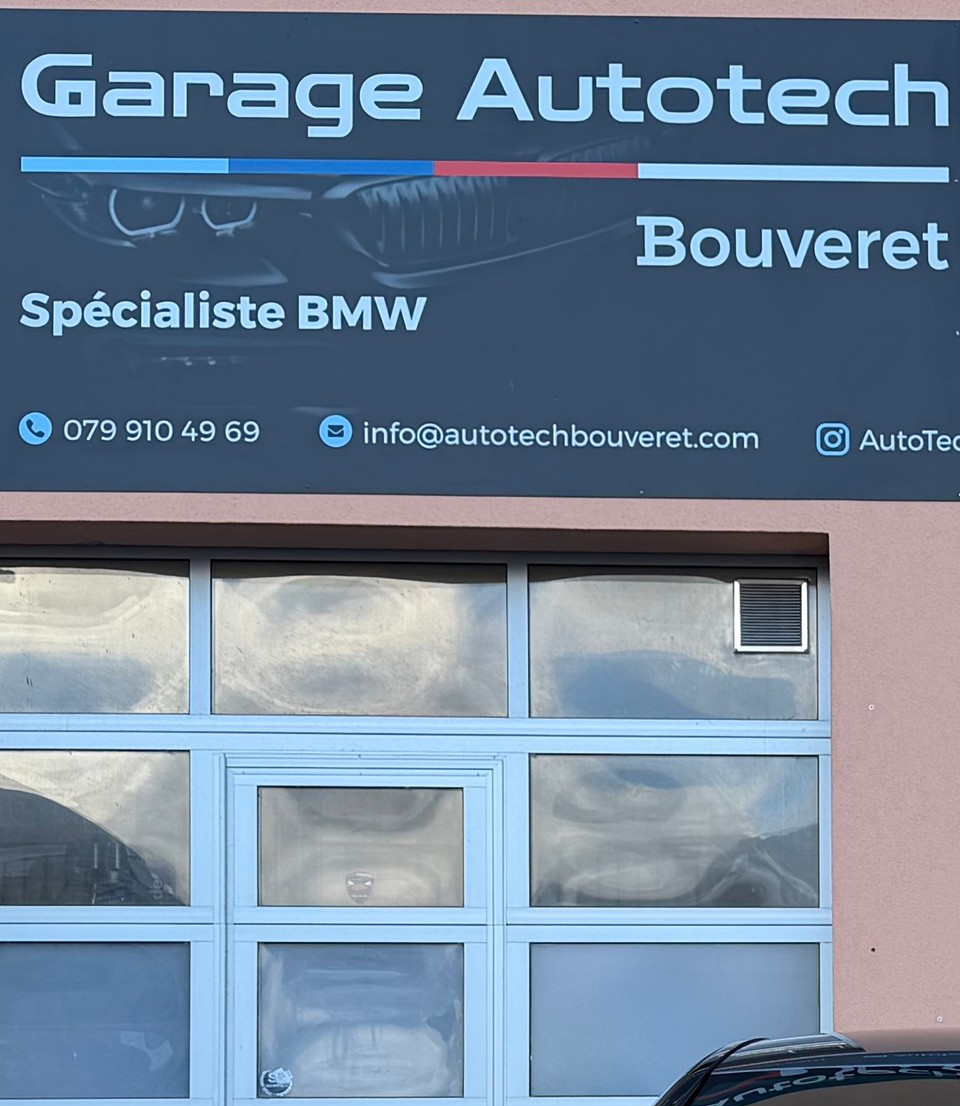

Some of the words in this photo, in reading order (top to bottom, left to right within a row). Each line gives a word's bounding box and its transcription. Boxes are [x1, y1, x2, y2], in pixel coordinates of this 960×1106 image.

[21, 53, 422, 138] Garage
[456, 58, 950, 127] Autotech
[636, 215, 950, 271] Bouveret
[20, 289, 285, 336] Spécialiste
[298, 295, 427, 331] BMW
[63, 419, 117, 441] 079
[126, 419, 174, 442] 910
[181, 420, 216, 442] 49
[224, 420, 260, 443] 69
[362, 421, 759, 450] info@autotechbouveret.com
